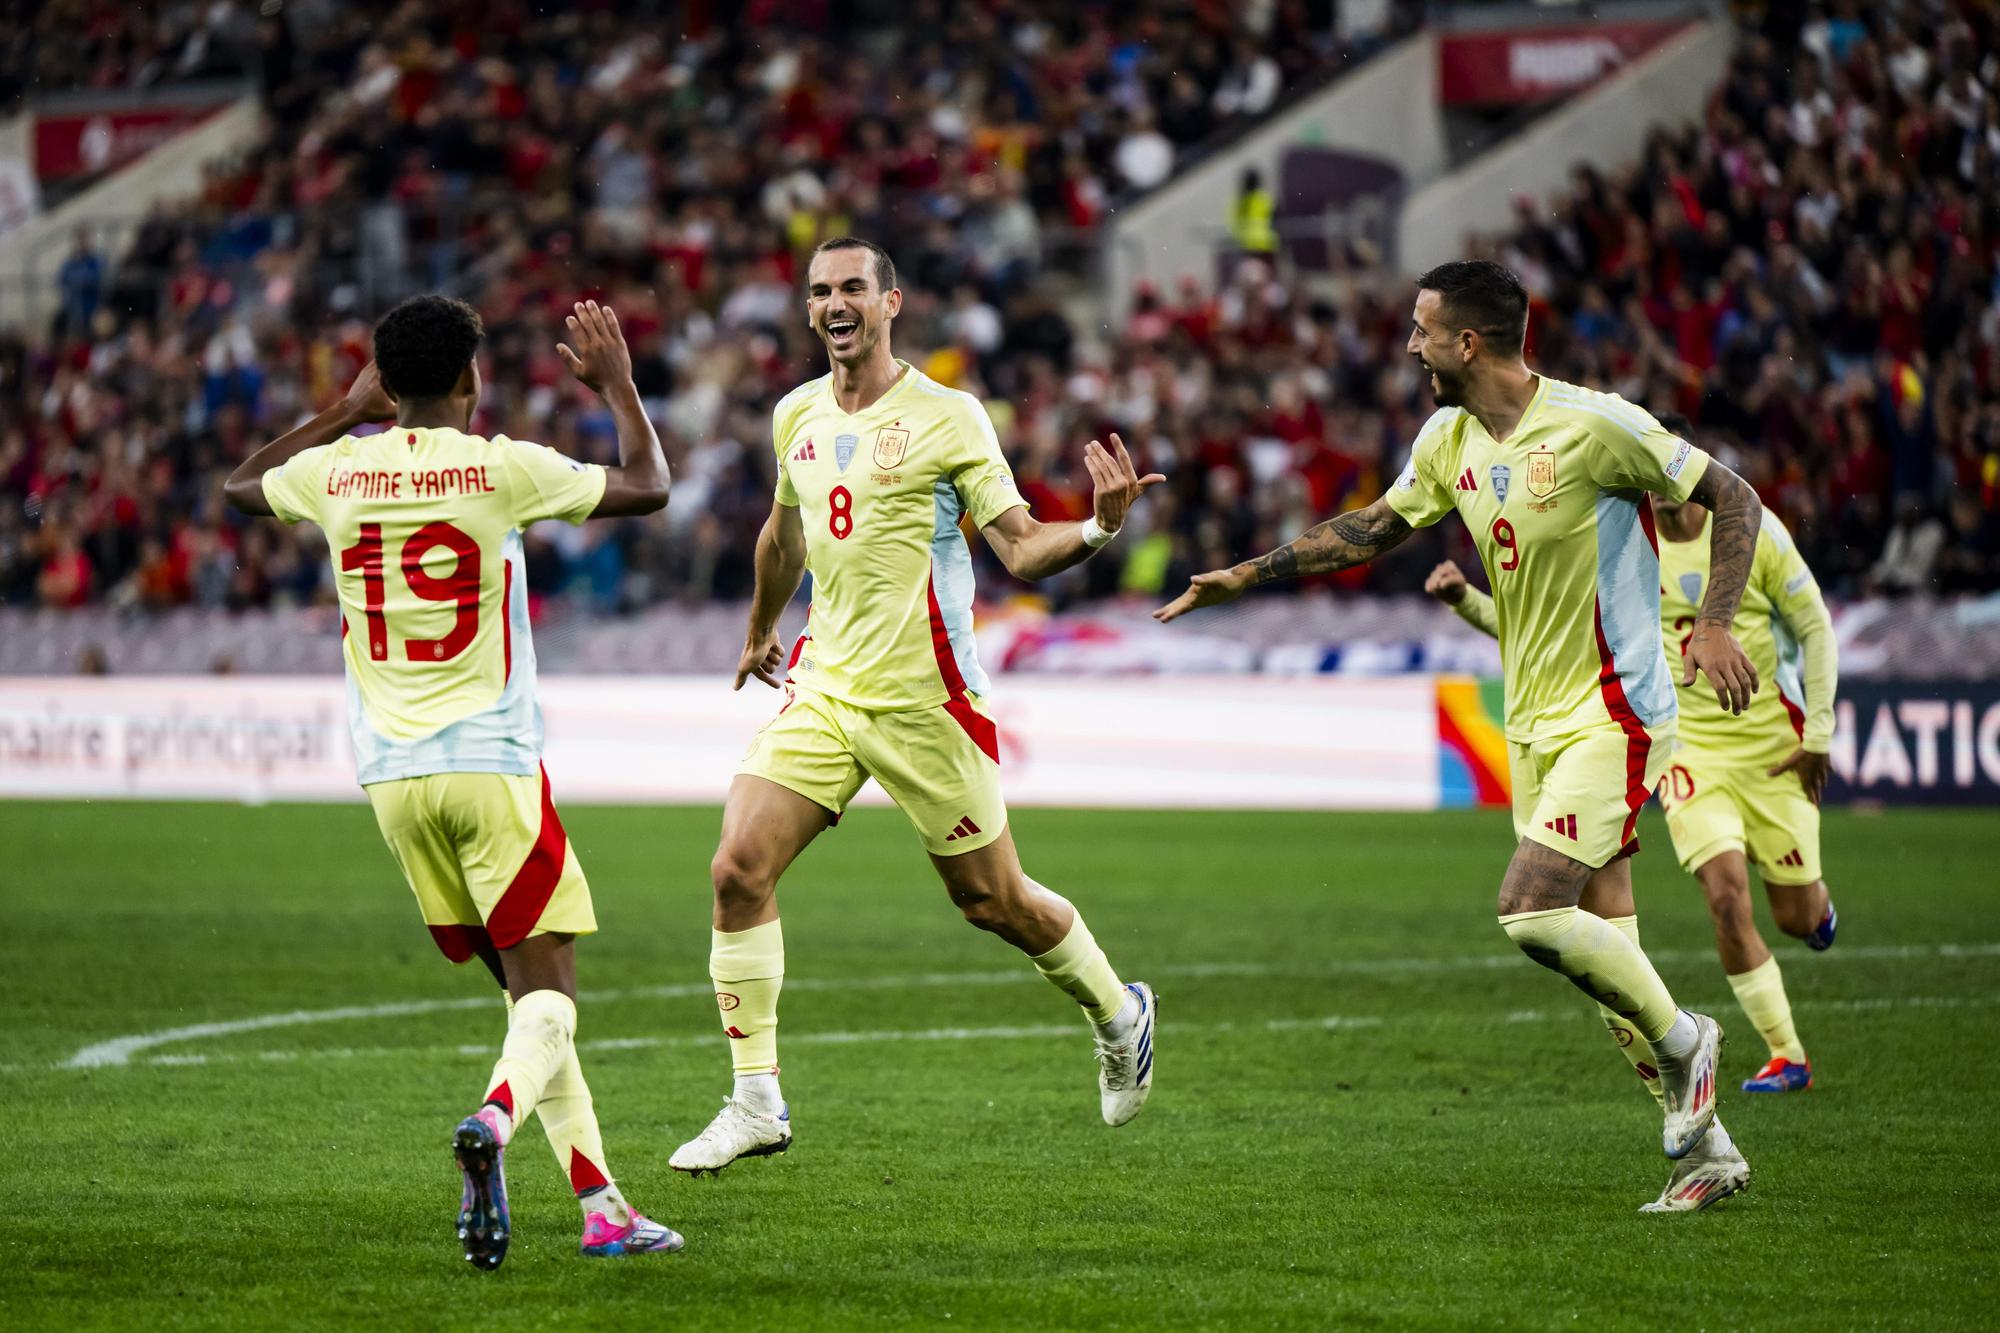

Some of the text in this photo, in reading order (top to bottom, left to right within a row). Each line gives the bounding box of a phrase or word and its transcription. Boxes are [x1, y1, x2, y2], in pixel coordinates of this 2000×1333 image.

[327, 465, 495, 499] LAMINE YAMAL
[829, 485, 853, 540] 8
[1492, 517, 1519, 571] 9
[341, 521, 481, 661] 19
[126, 697, 334, 789] principal
